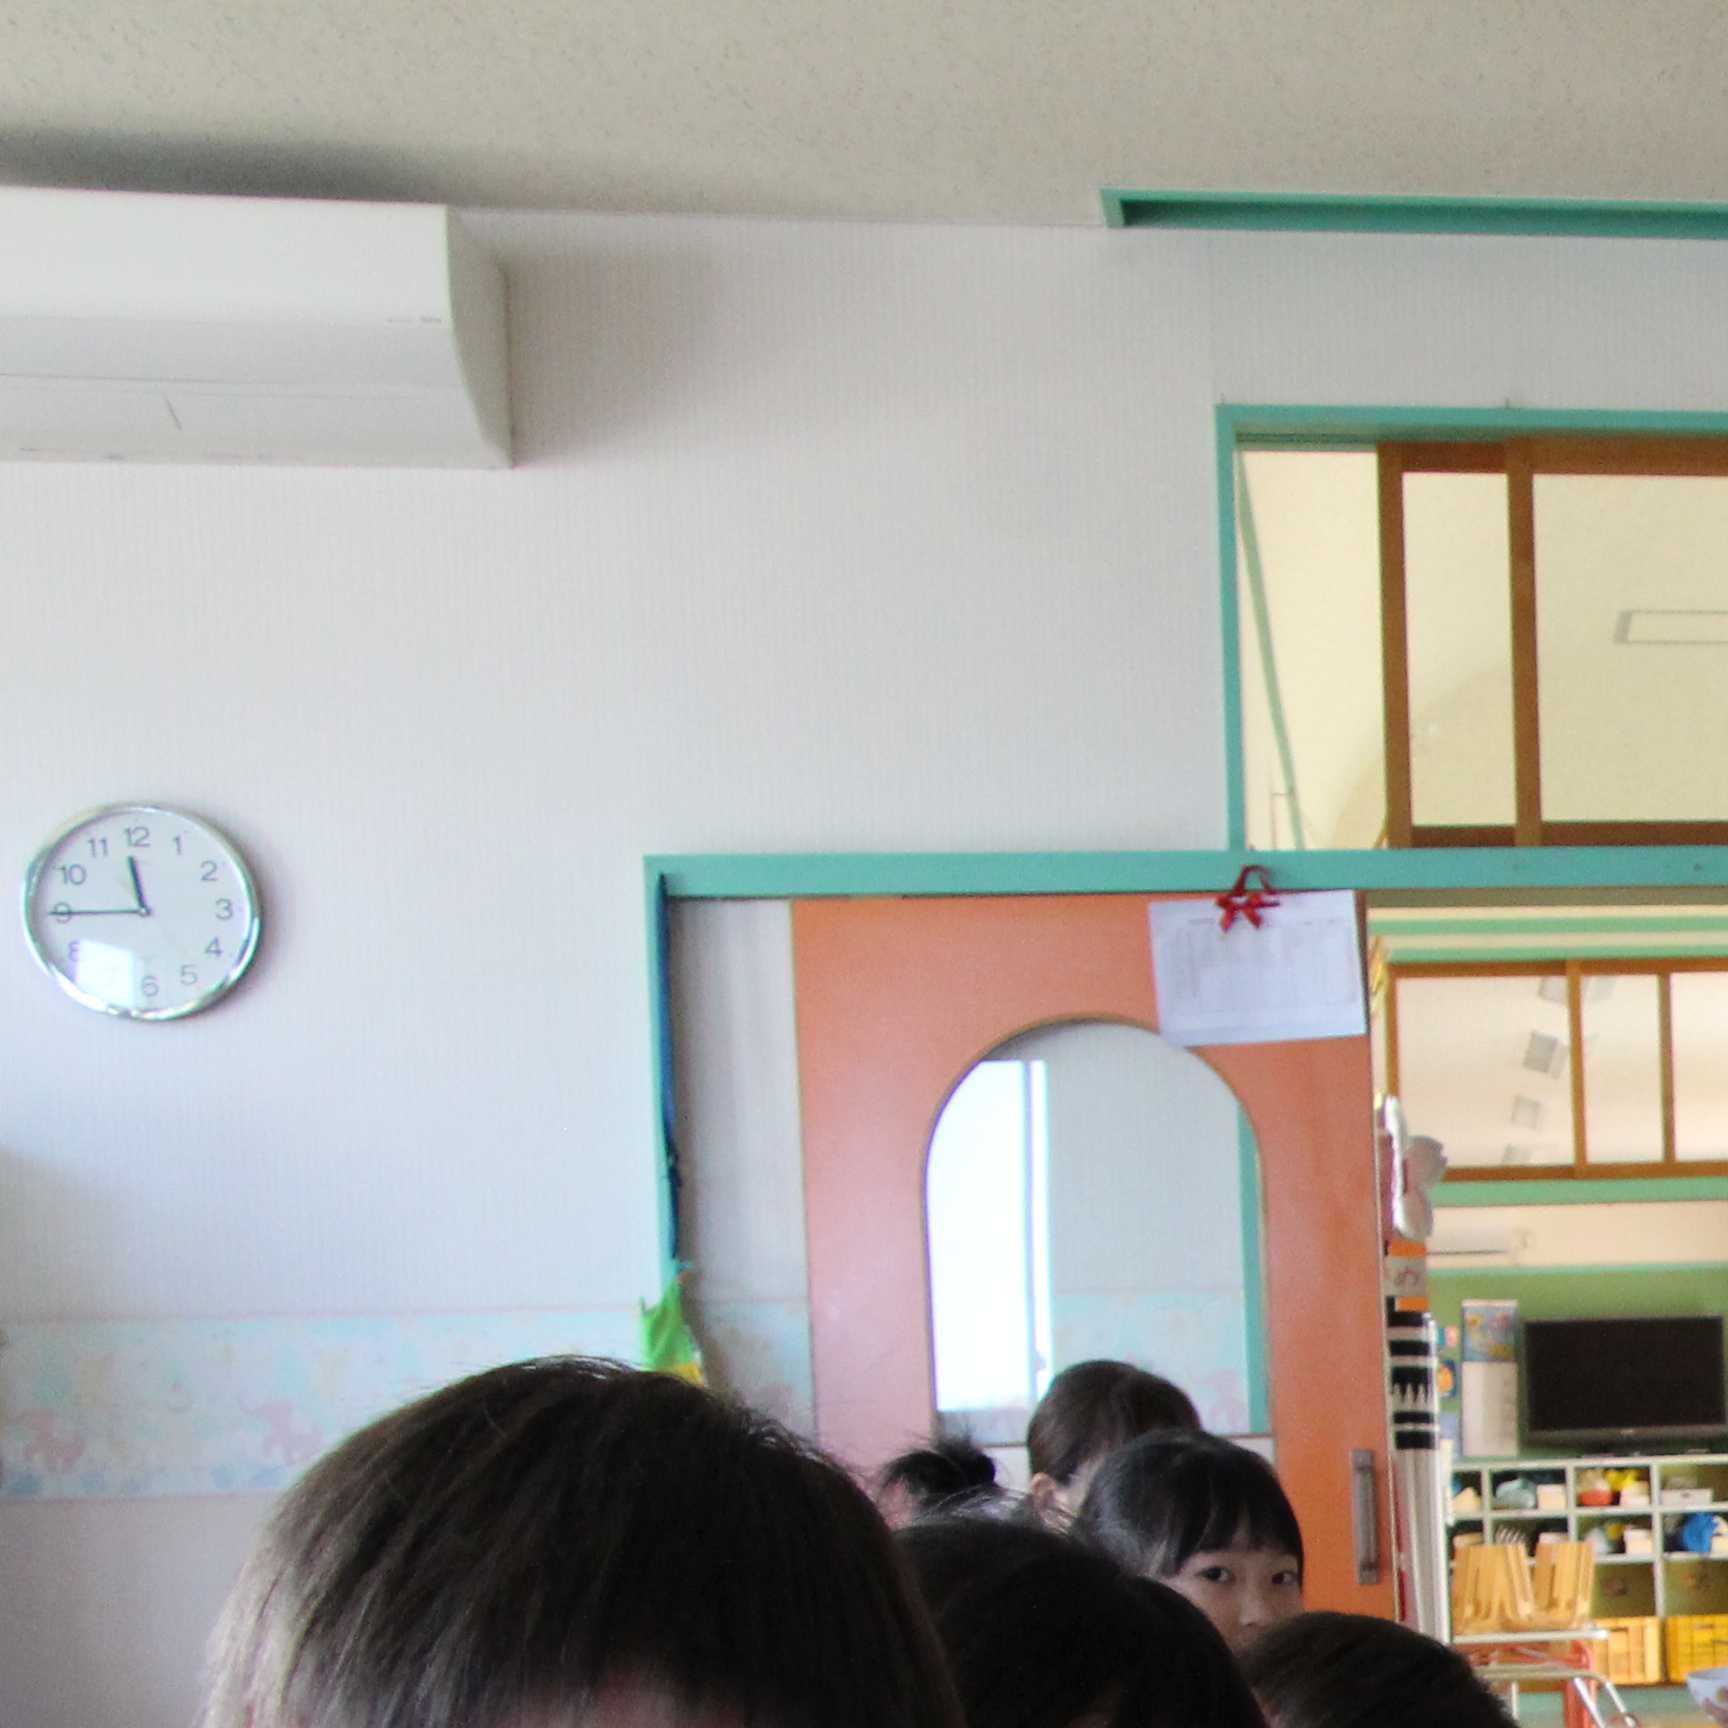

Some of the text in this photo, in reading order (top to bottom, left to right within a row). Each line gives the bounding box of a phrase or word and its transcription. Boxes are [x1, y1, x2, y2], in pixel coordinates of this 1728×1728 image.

[88, 837, 108, 858] 11
[123, 826, 150, 848] 12
[172, 834, 183, 856] 1
[59, 863, 87, 886] 10
[200, 860, 218, 882] 2
[53, 902, 72, 923] 9
[215, 898, 234, 921] 3
[204, 936, 223, 958] 4
[141, 975, 160, 997] 6
[180, 964, 197, 986] 5
